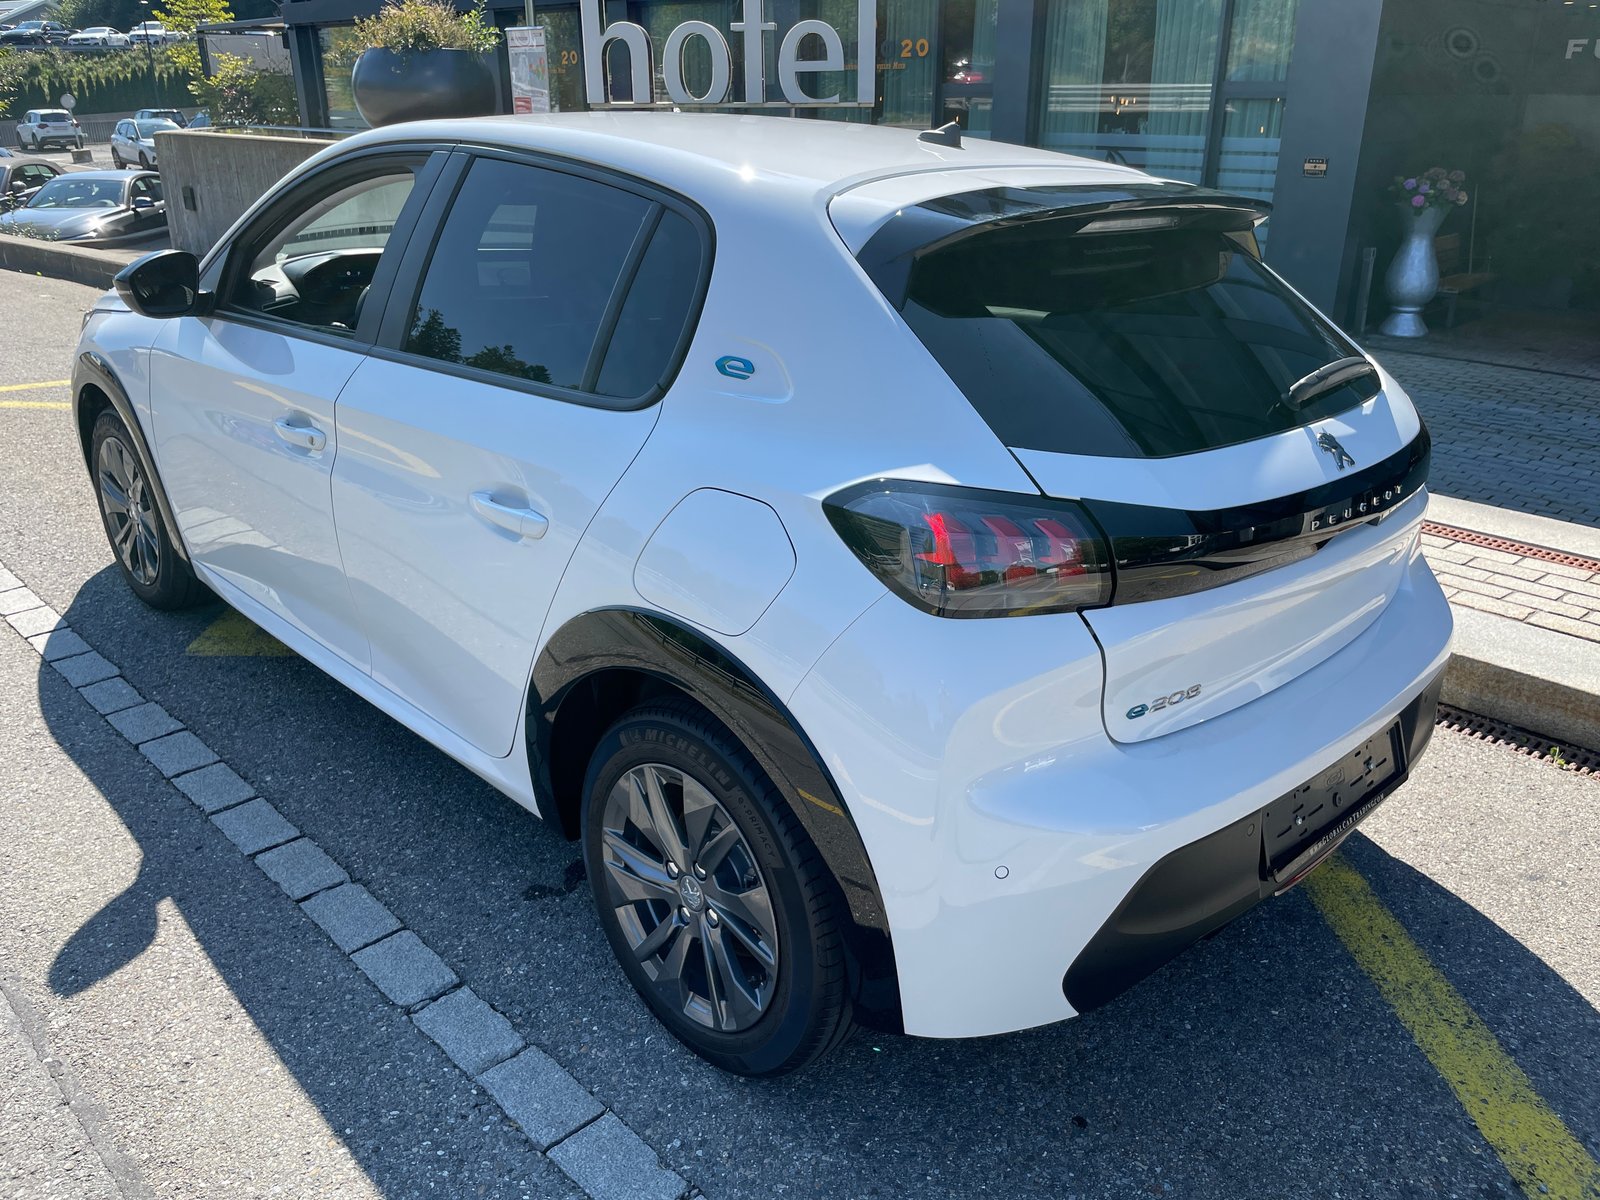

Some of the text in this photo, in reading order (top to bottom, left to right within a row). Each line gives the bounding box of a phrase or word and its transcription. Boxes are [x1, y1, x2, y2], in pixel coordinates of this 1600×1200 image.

[561, 50, 578, 65] 20
[580, 0, 876, 104] hotel
[901, 38, 929, 58] 20
[715, 355, 755, 380] e
[1311, 485, 1402, 531] PEUGEOT
[645, 728, 731, 785] MICHELIN
